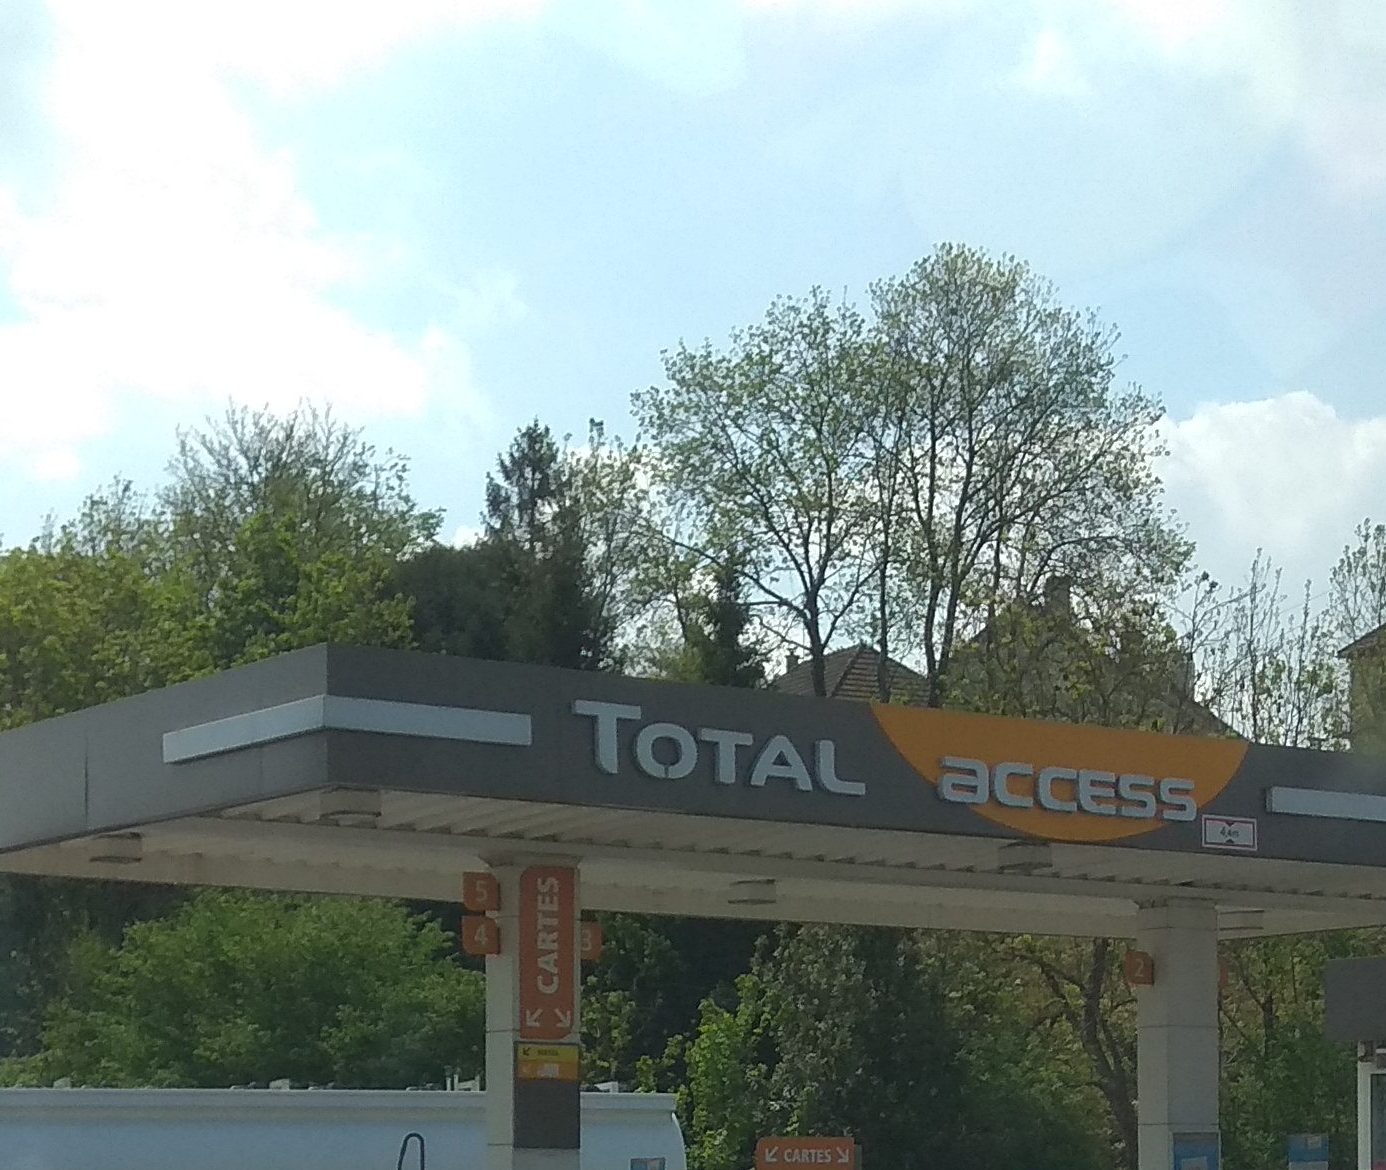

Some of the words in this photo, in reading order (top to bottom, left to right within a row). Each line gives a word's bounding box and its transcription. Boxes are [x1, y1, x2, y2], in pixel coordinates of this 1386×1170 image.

[572, 699, 867, 796] TOTAL
[938, 756, 1198, 822] access
[476, 879, 488, 903] 5
[474, 923, 489, 946] 4
[536, 876, 560, 994] CARTES
[1133, 957, 1144, 979] 2
[784, 1147, 832, 1164] CARTES
